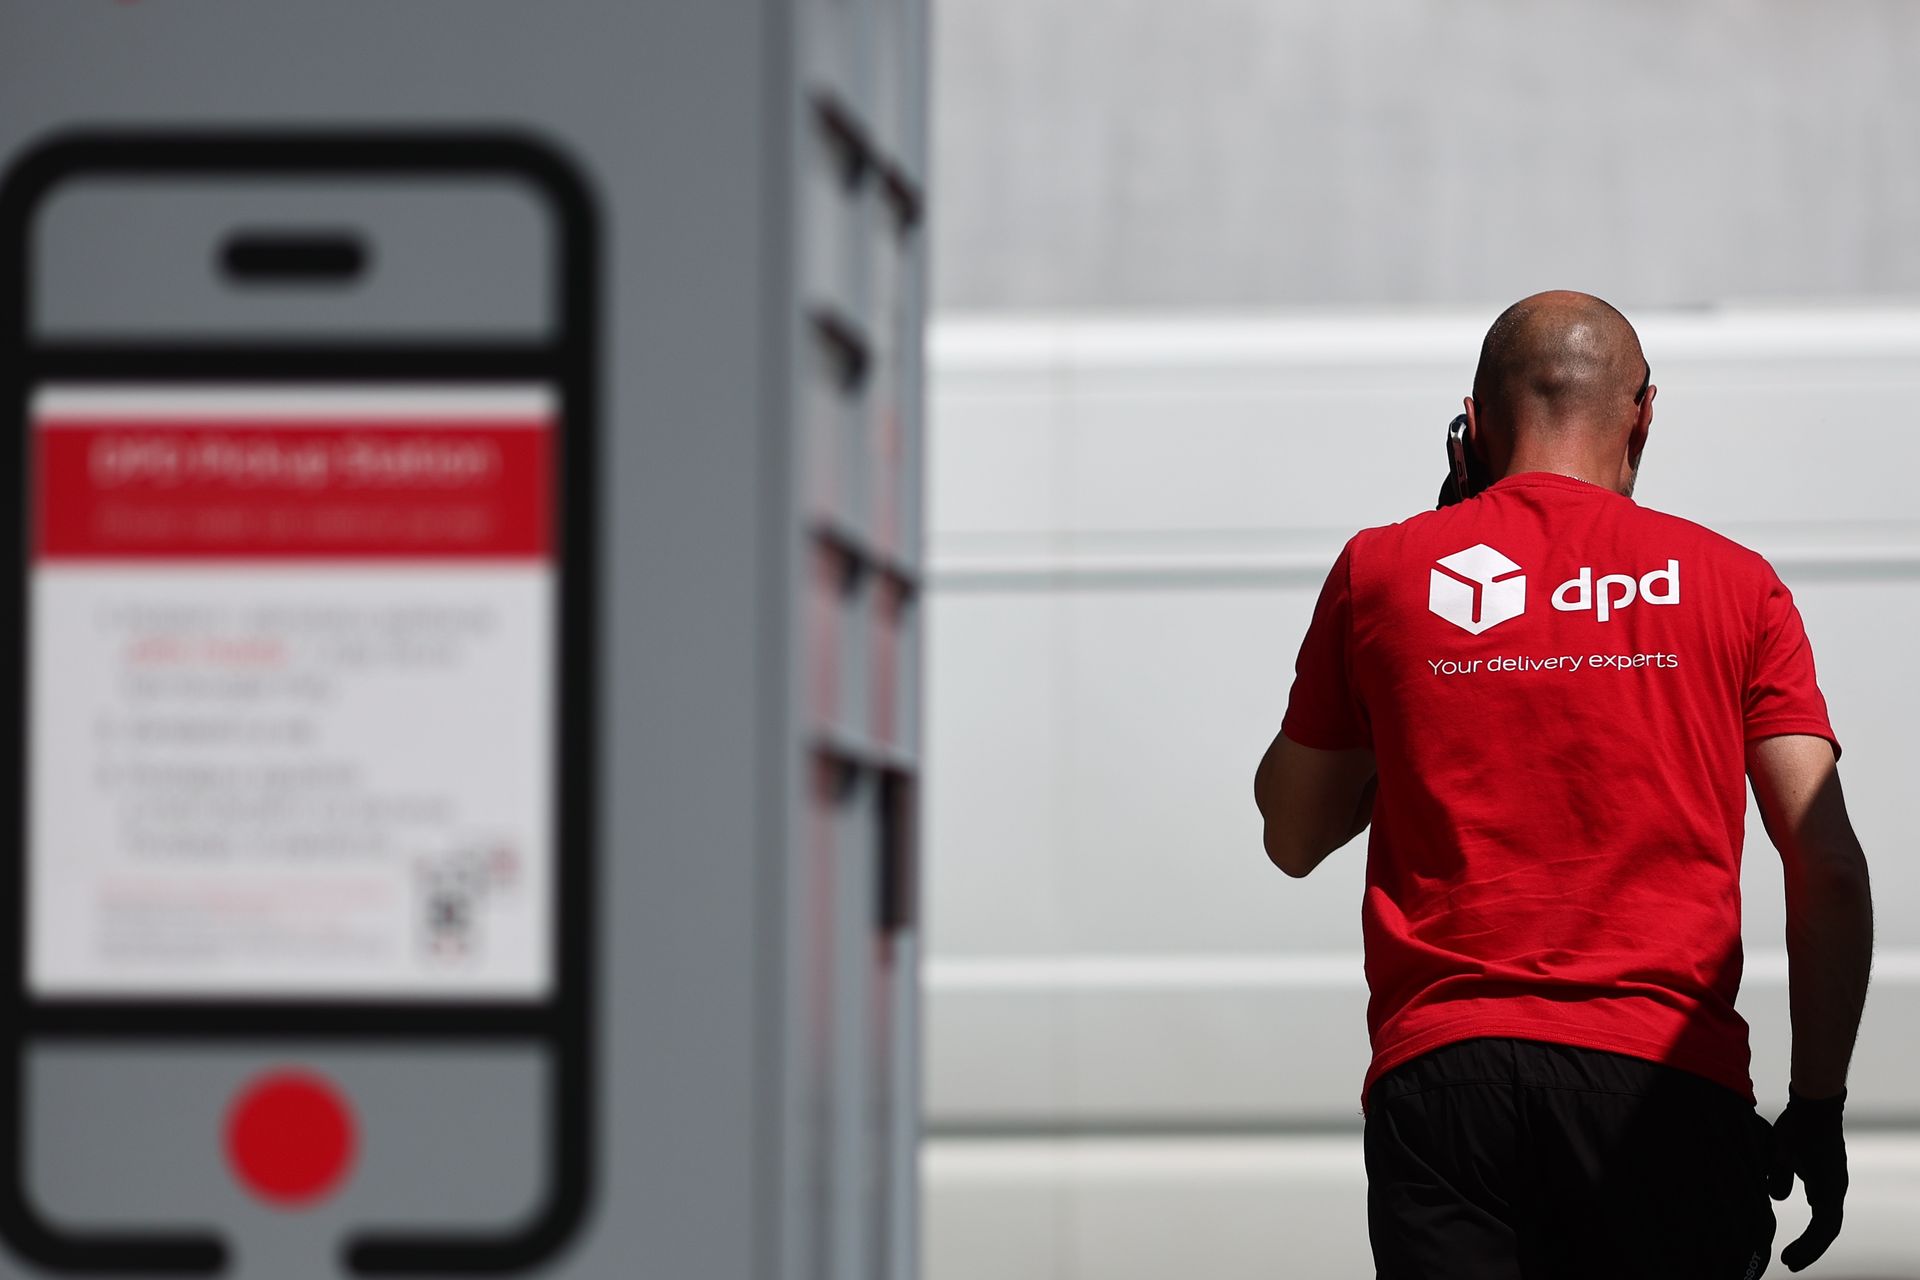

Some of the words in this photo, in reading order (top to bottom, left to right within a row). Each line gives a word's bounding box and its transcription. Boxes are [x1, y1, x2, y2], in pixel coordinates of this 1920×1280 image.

[1551, 559, 1680, 622] dpd
[1427, 658, 1483, 676] Your
[1487, 655, 1584, 672] delivery
[1588, 651, 1679, 671] experts
